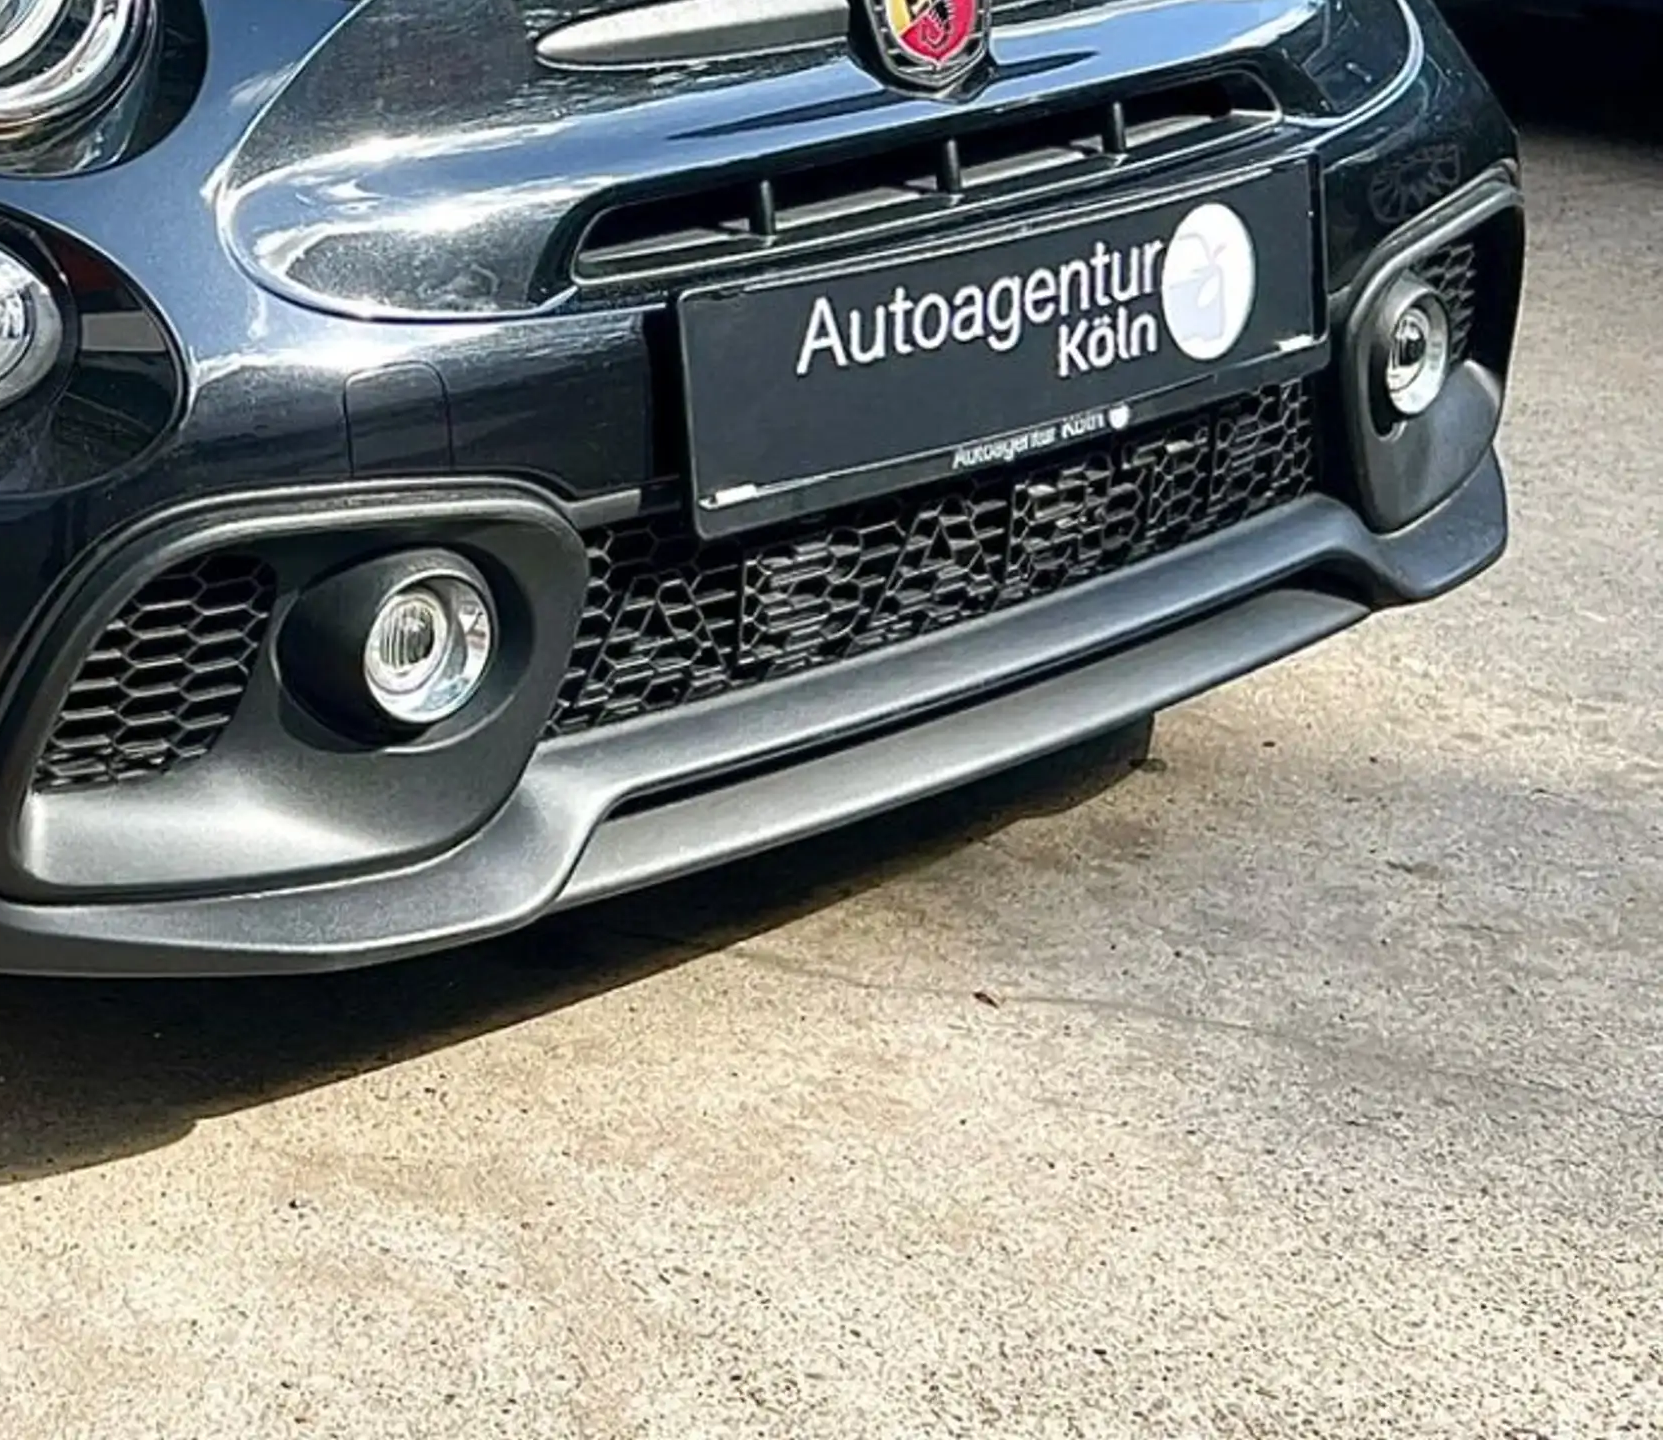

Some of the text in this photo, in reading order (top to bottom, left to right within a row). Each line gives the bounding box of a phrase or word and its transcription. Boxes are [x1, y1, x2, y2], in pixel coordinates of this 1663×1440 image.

[795, 239, 1164, 376] Autoagentur
[1057, 309, 1158, 378] Köln
[1061, 411, 1105, 439] Köln
